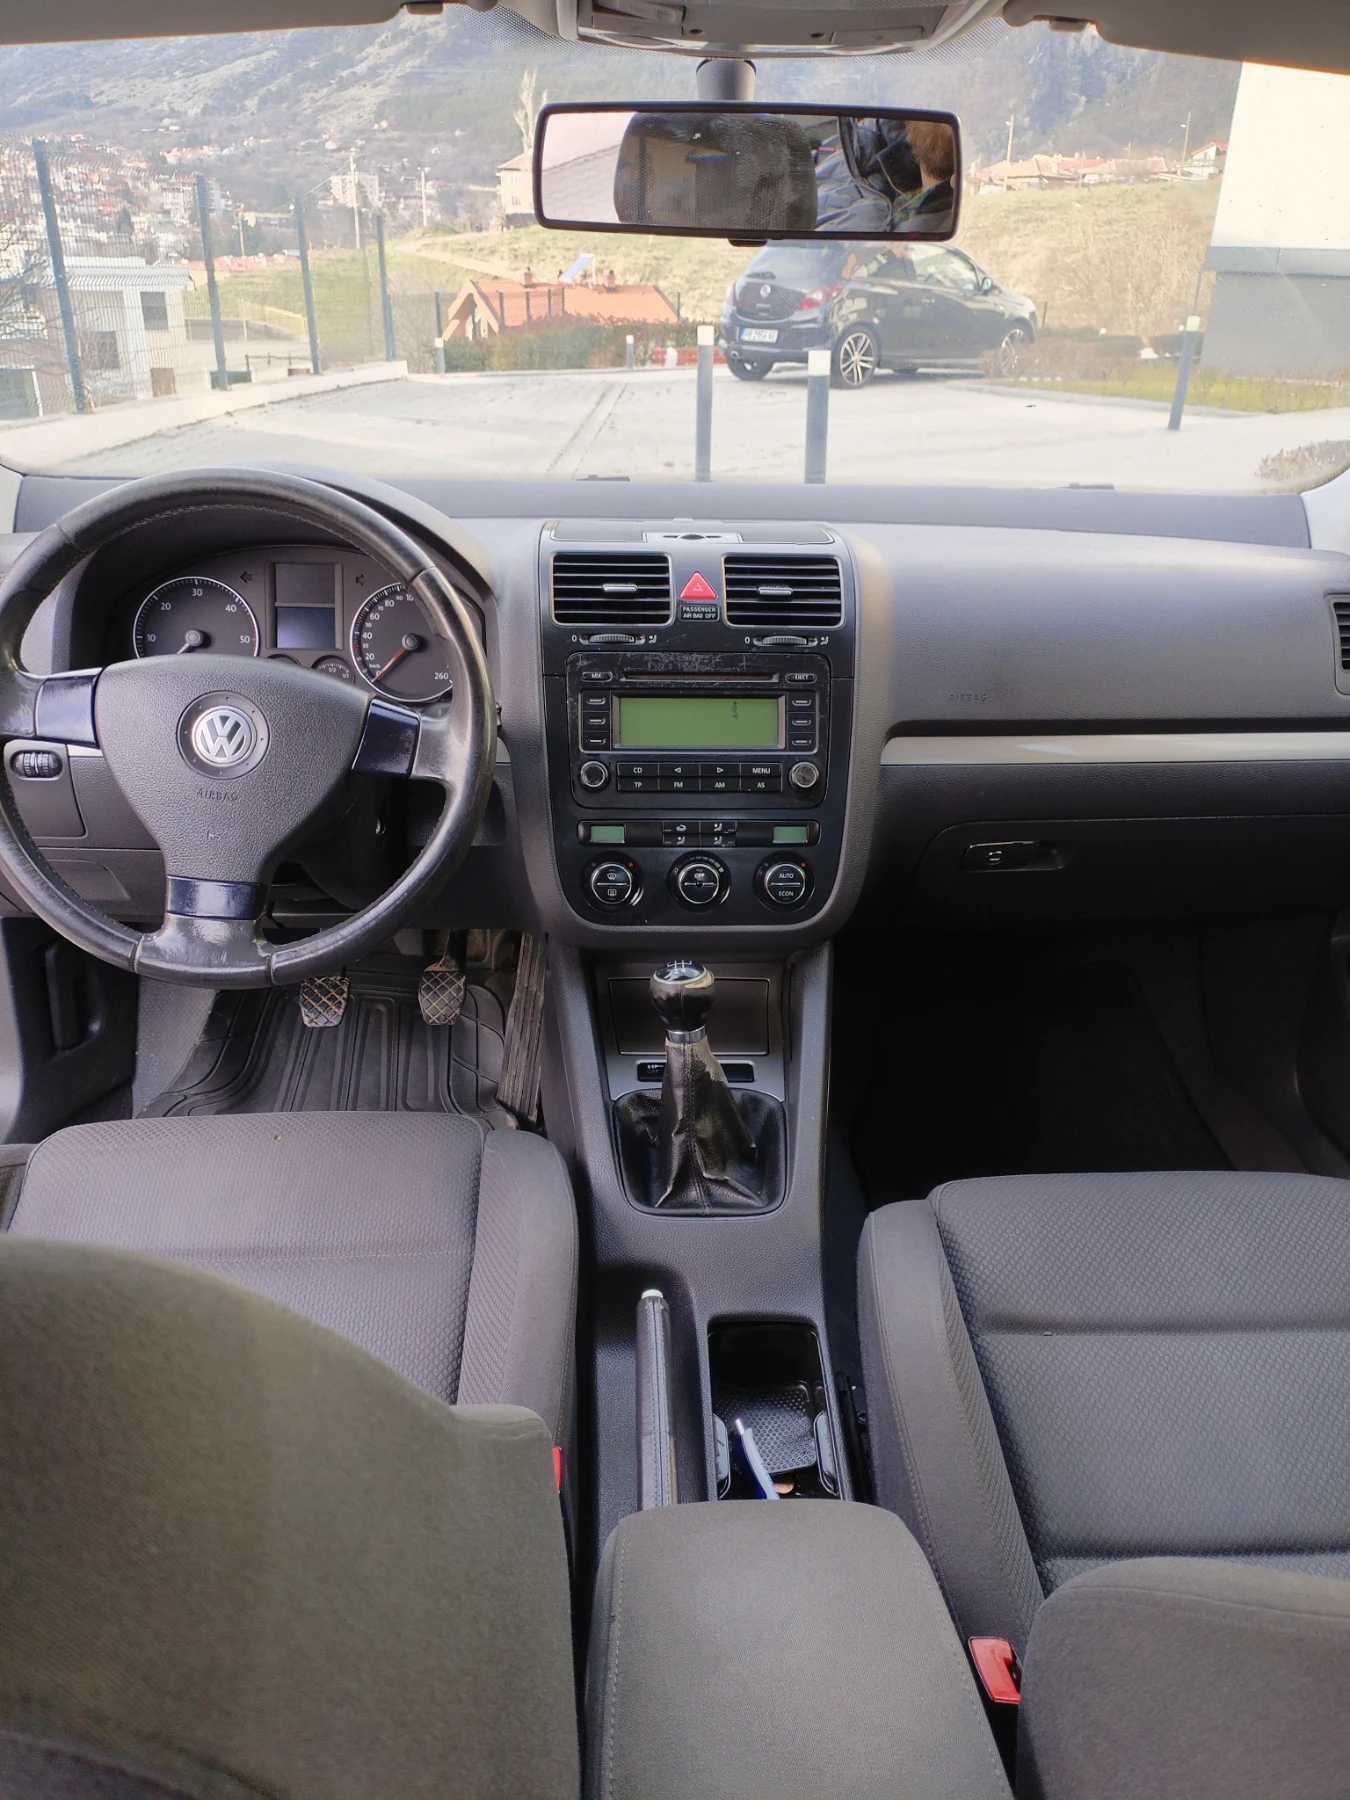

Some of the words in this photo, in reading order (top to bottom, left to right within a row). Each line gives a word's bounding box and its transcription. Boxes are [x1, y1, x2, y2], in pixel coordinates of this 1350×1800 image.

[192, 588, 203, 597] 30
[160, 602, 172, 611] 20
[384, 599, 395, 608] 80
[225, 604, 237, 613] 40
[369, 612, 380, 621] 60
[146, 634, 157, 642] 10
[240, 635, 251, 644] 50
[362, 632, 373, 640] 40
[364, 652, 375, 661] 20
[434, 672, 449, 680] 260
[192, 706, 257, 767] VW
[195, 789, 240, 801] AIRBAG
